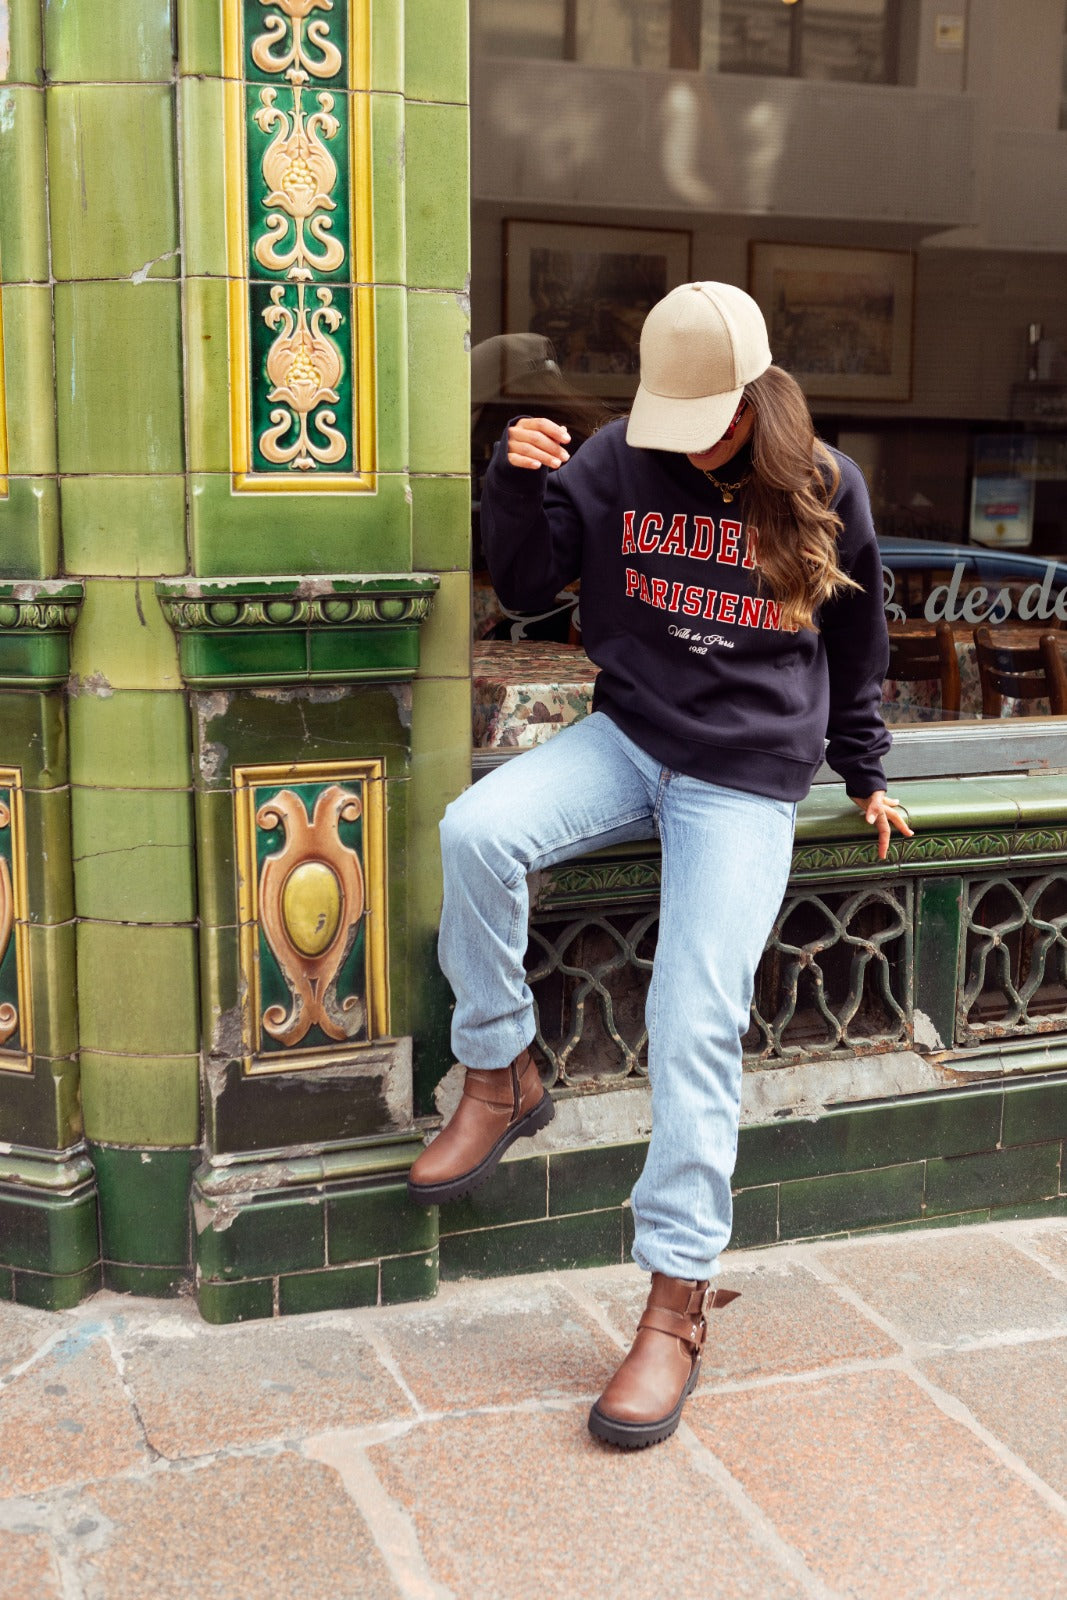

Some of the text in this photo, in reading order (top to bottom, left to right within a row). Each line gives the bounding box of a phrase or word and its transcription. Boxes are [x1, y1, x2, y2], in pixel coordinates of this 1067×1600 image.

[625, 567, 800, 633] PARISIENN
[668, 624, 735, 648] Ville de Paris
